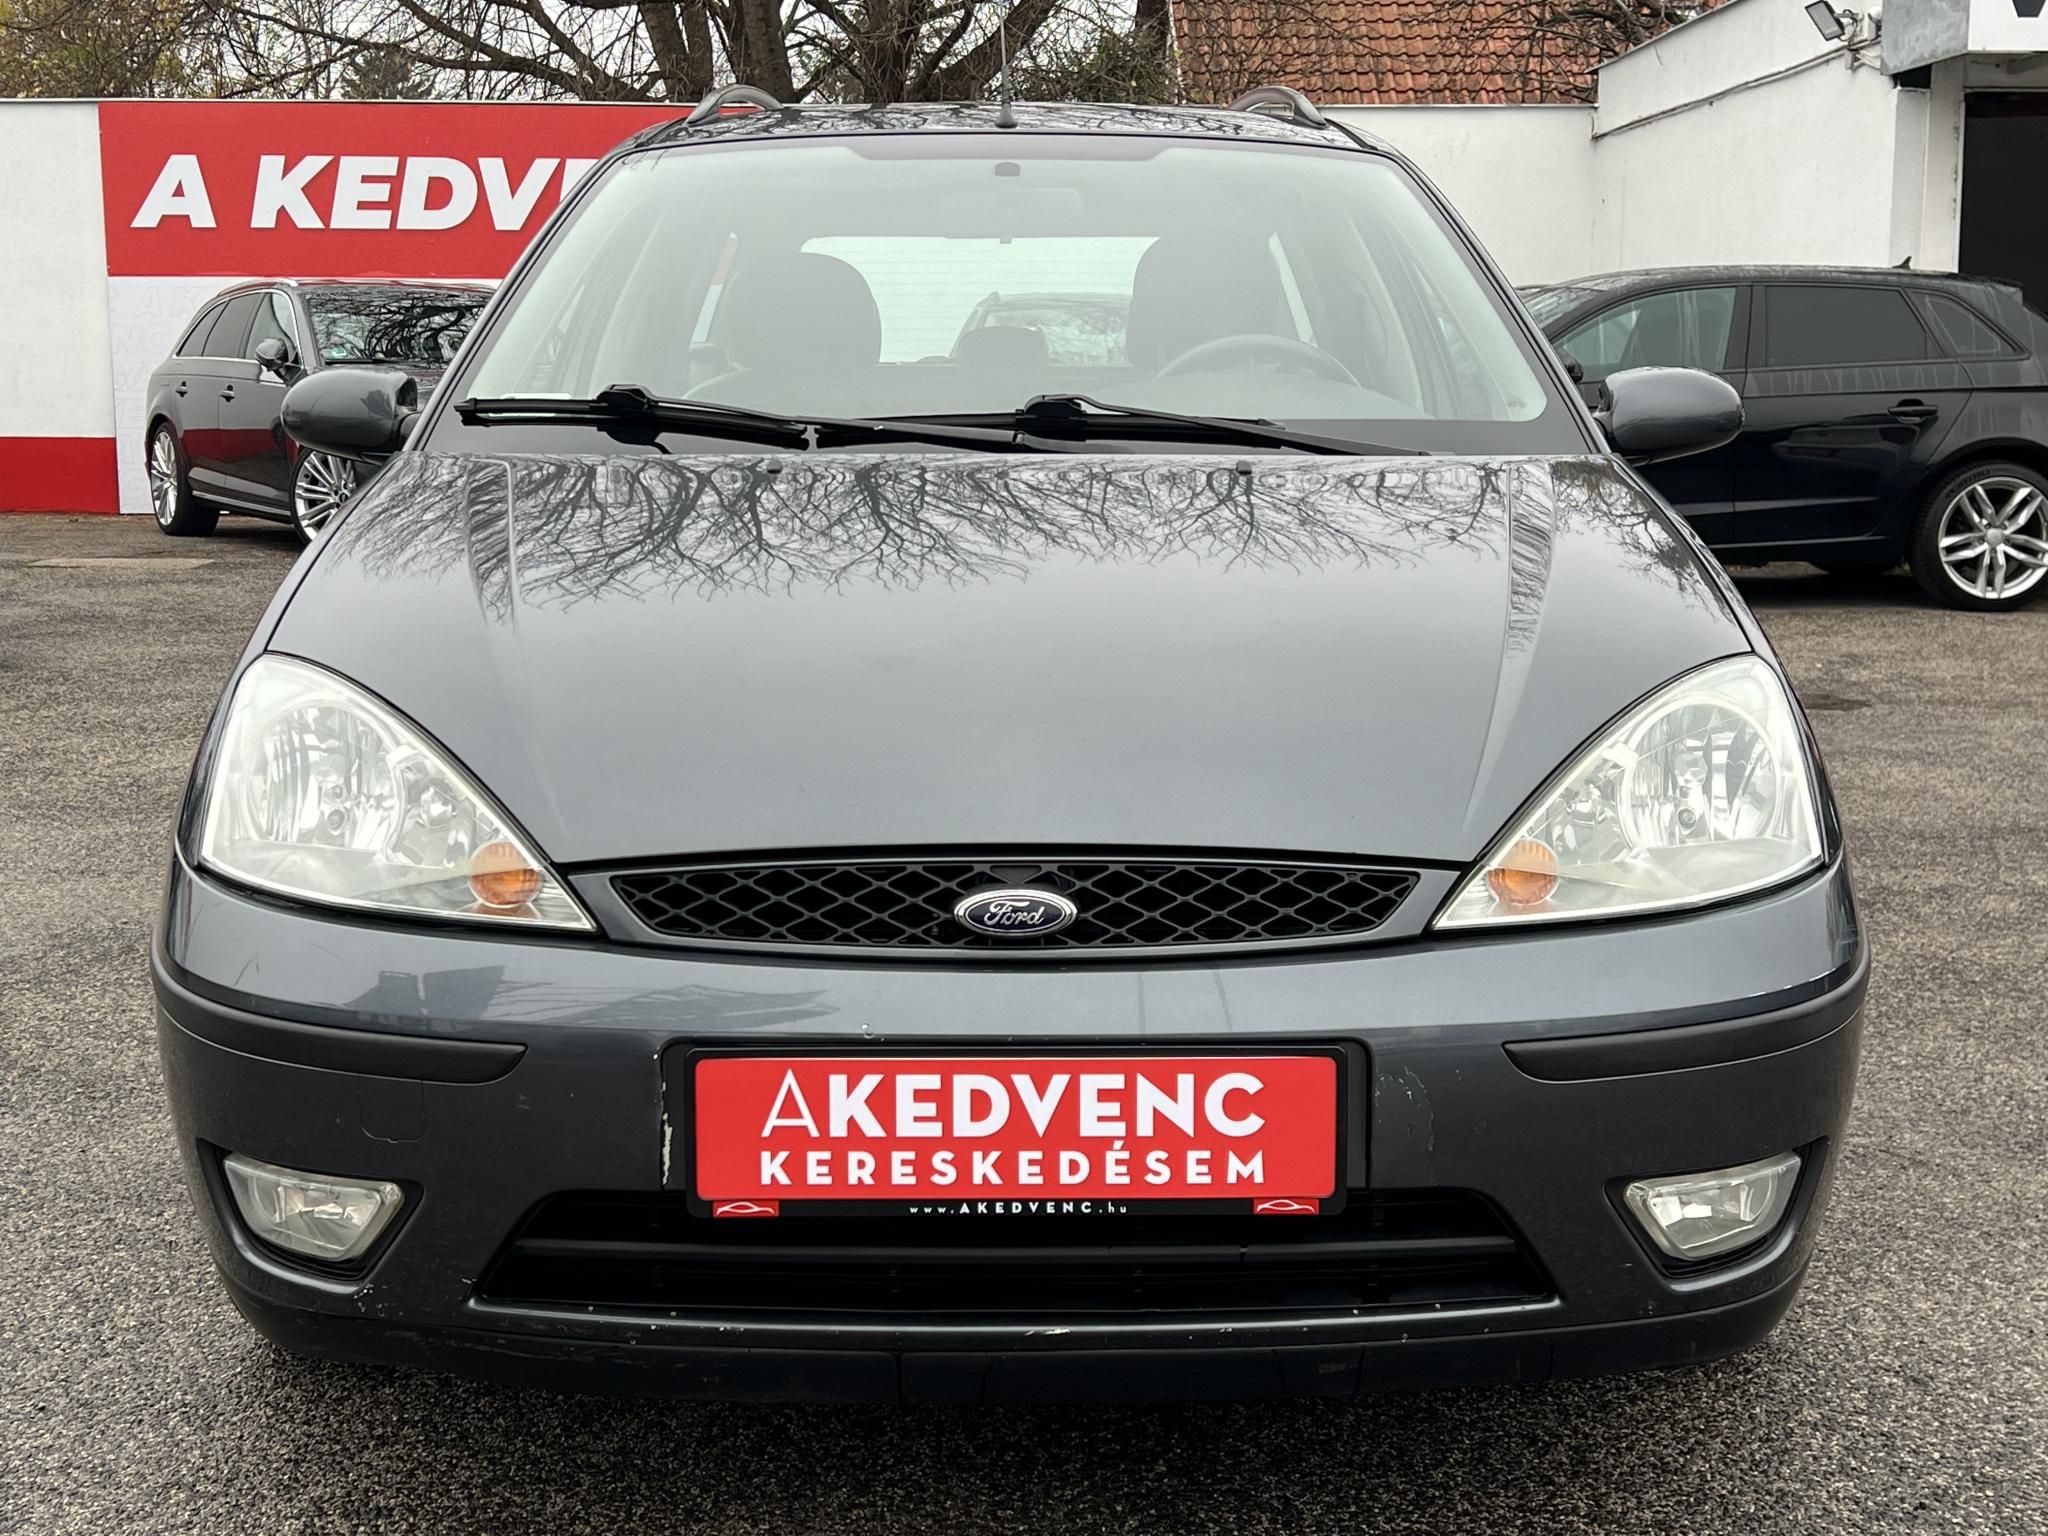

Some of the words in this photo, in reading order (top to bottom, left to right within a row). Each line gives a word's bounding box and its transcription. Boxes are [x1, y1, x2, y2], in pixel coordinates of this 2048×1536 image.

[130, 154, 217, 228] A
[984, 900, 1045, 926] Ford
[760, 1140, 1266, 1186] KERESKEDÉSEM
[909, 1201, 1128, 1215] www.AKEDVENC.hu
